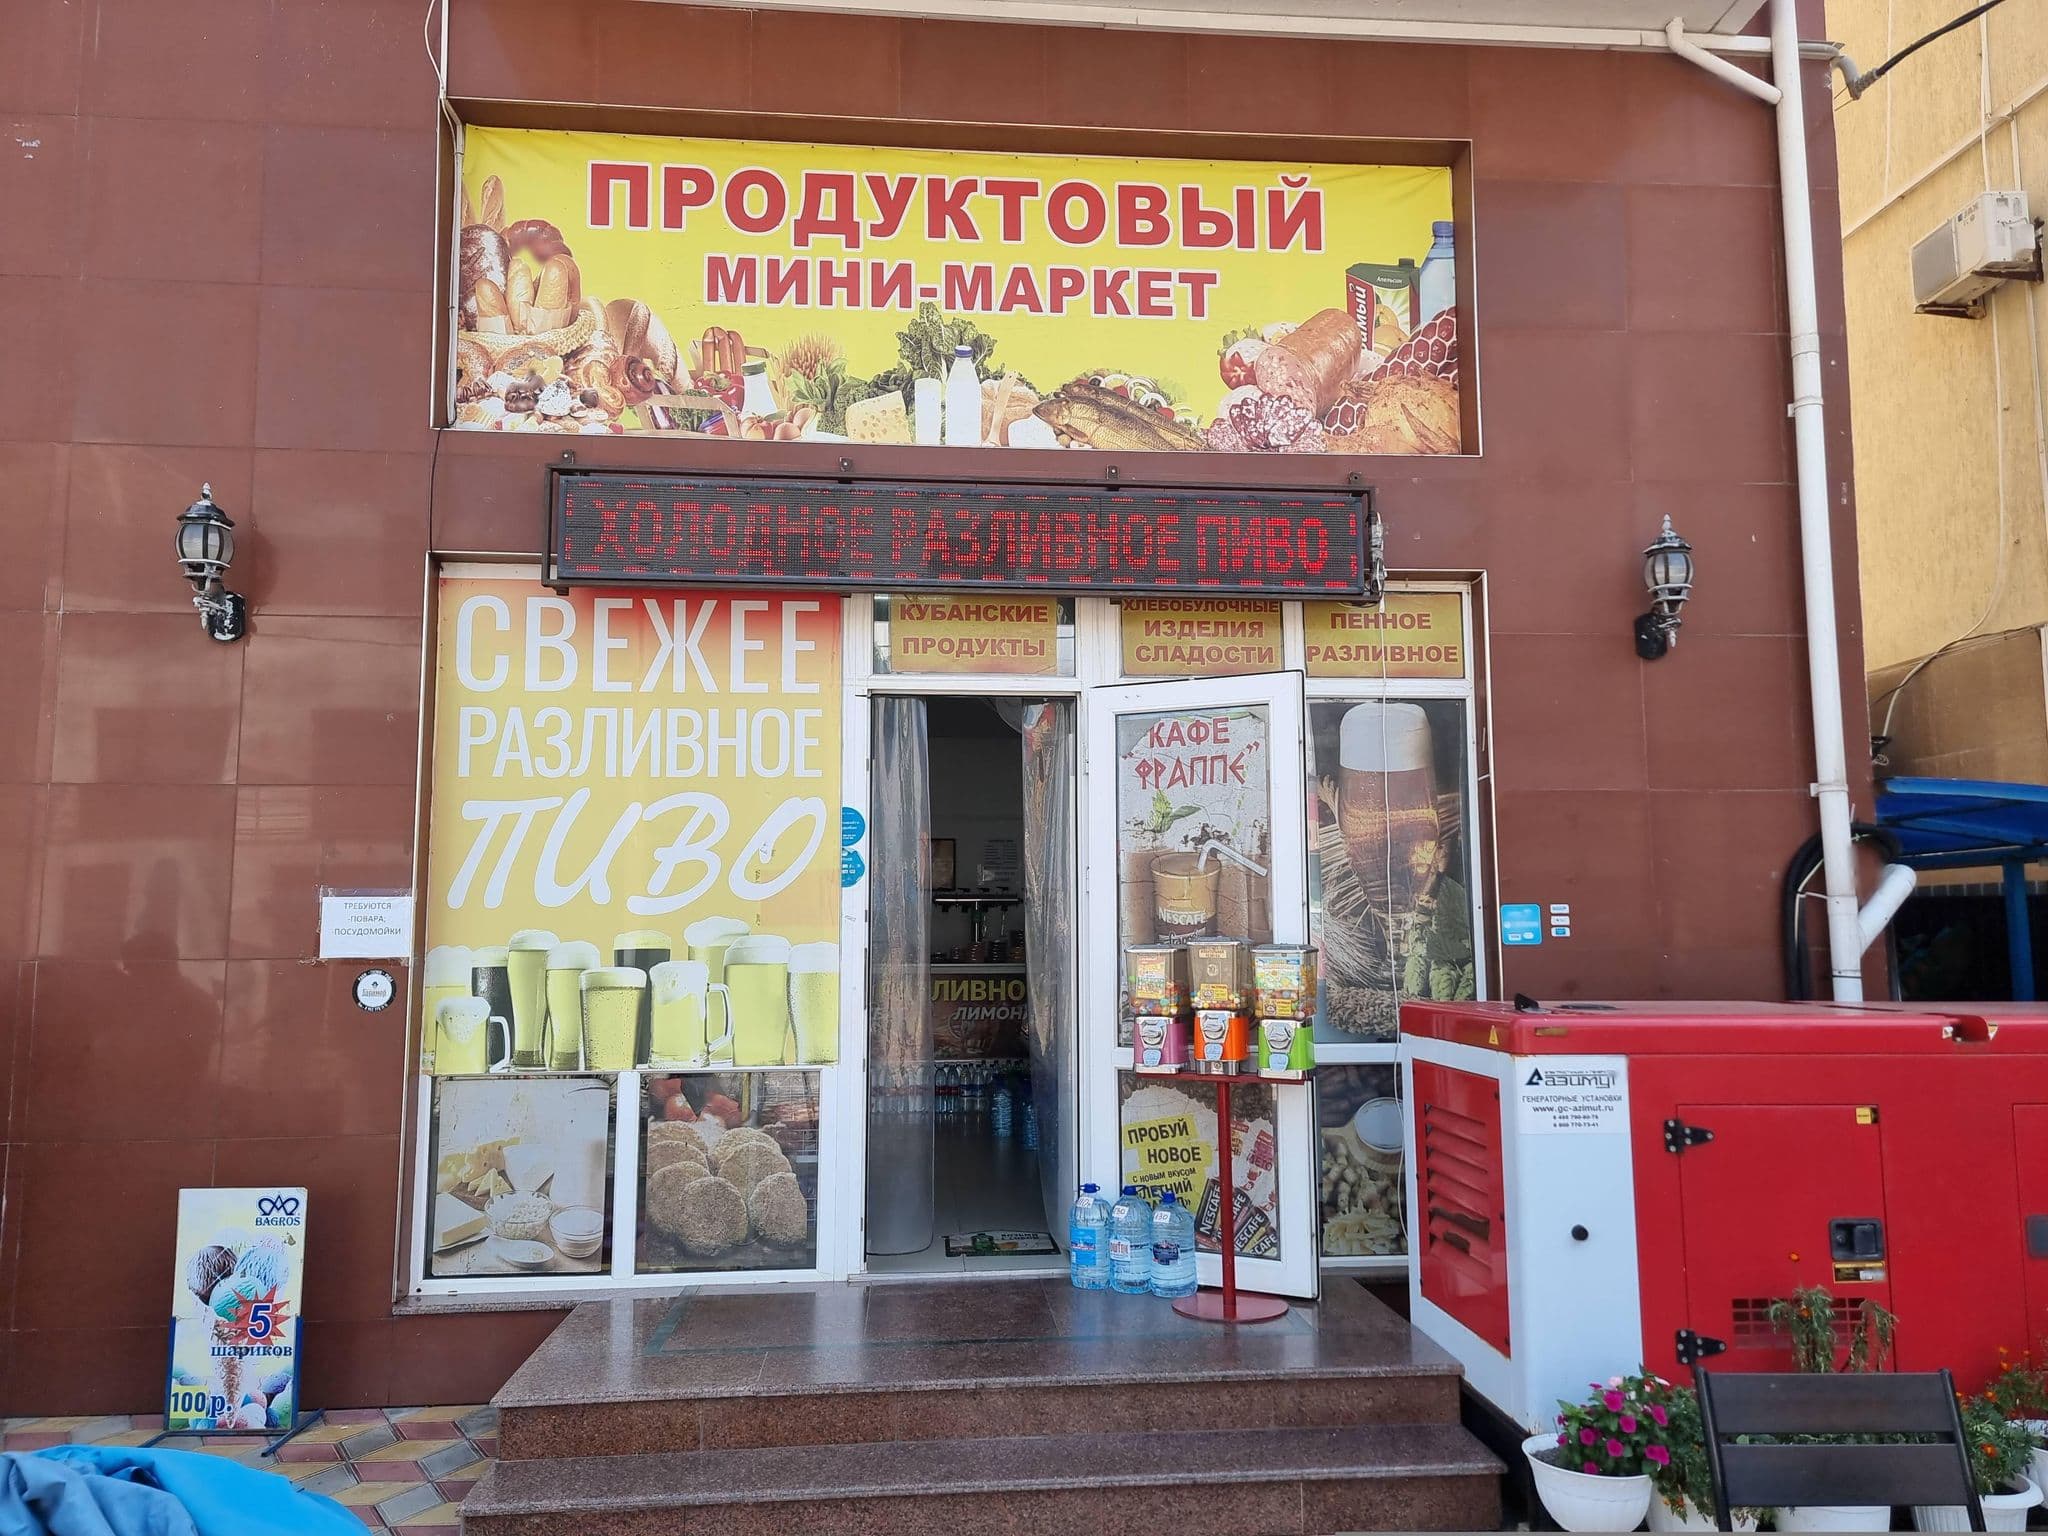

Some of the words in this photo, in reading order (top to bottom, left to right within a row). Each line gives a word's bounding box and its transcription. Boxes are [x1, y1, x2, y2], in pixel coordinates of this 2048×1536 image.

[588, 161, 1324, 252] ПРОДУКТОВЫЙ
[705, 256, 1218, 318] МИНИ-МАРКЕТ
[592, 499, 874, 567] ХОЛОДНОЕ
[891, 507, 1181, 571] РАЗЛИВНОЕ
[1196, 514, 1328, 575] ПИВО
[899, 603, 1049, 623] КУБАНСКИЕ
[1122, 599, 1280, 613] ХЛЕБОБУЛОЧНЫЕ
[1144, 619, 1264, 641] ИЗДЕЛИЯ
[1329, 612, 1432, 630] ПЕННОЕ
[455, 594, 821, 694] СВЕЖЕЕ
[902, 637, 1046, 658] ПРОДУКТЫ
[1307, 644, 1459, 664] РАЗЛИВНОЕ
[1135, 644, 1274, 667] СЛАДОСТИ
[457, 706, 823, 778] РАЗЛИВНОЕ
[1149, 716, 1231, 749] КАФЕ
[446, 787, 828, 915] ПИВО
[344, 902, 392, 910] ТРЕБУЮТСЯ
[931, 979, 1026, 1002] ЛИВНО
[1522, 1095, 1578, 1103] ГЕНЕРАТОРНЫЕ
[1532, 1104, 1614, 1113] www.gc-azimut.ru
[1127, 1118, 1189, 1144] ПРОБУЙ
[1147, 1146, 1202, 1164] НОВОЕ
[255, 1216, 301, 1227] BAGROS
[248, 1303, 272, 1339] 5
[210, 1344, 293, 1360] шариков
[171, 1391, 206, 1412] 100
